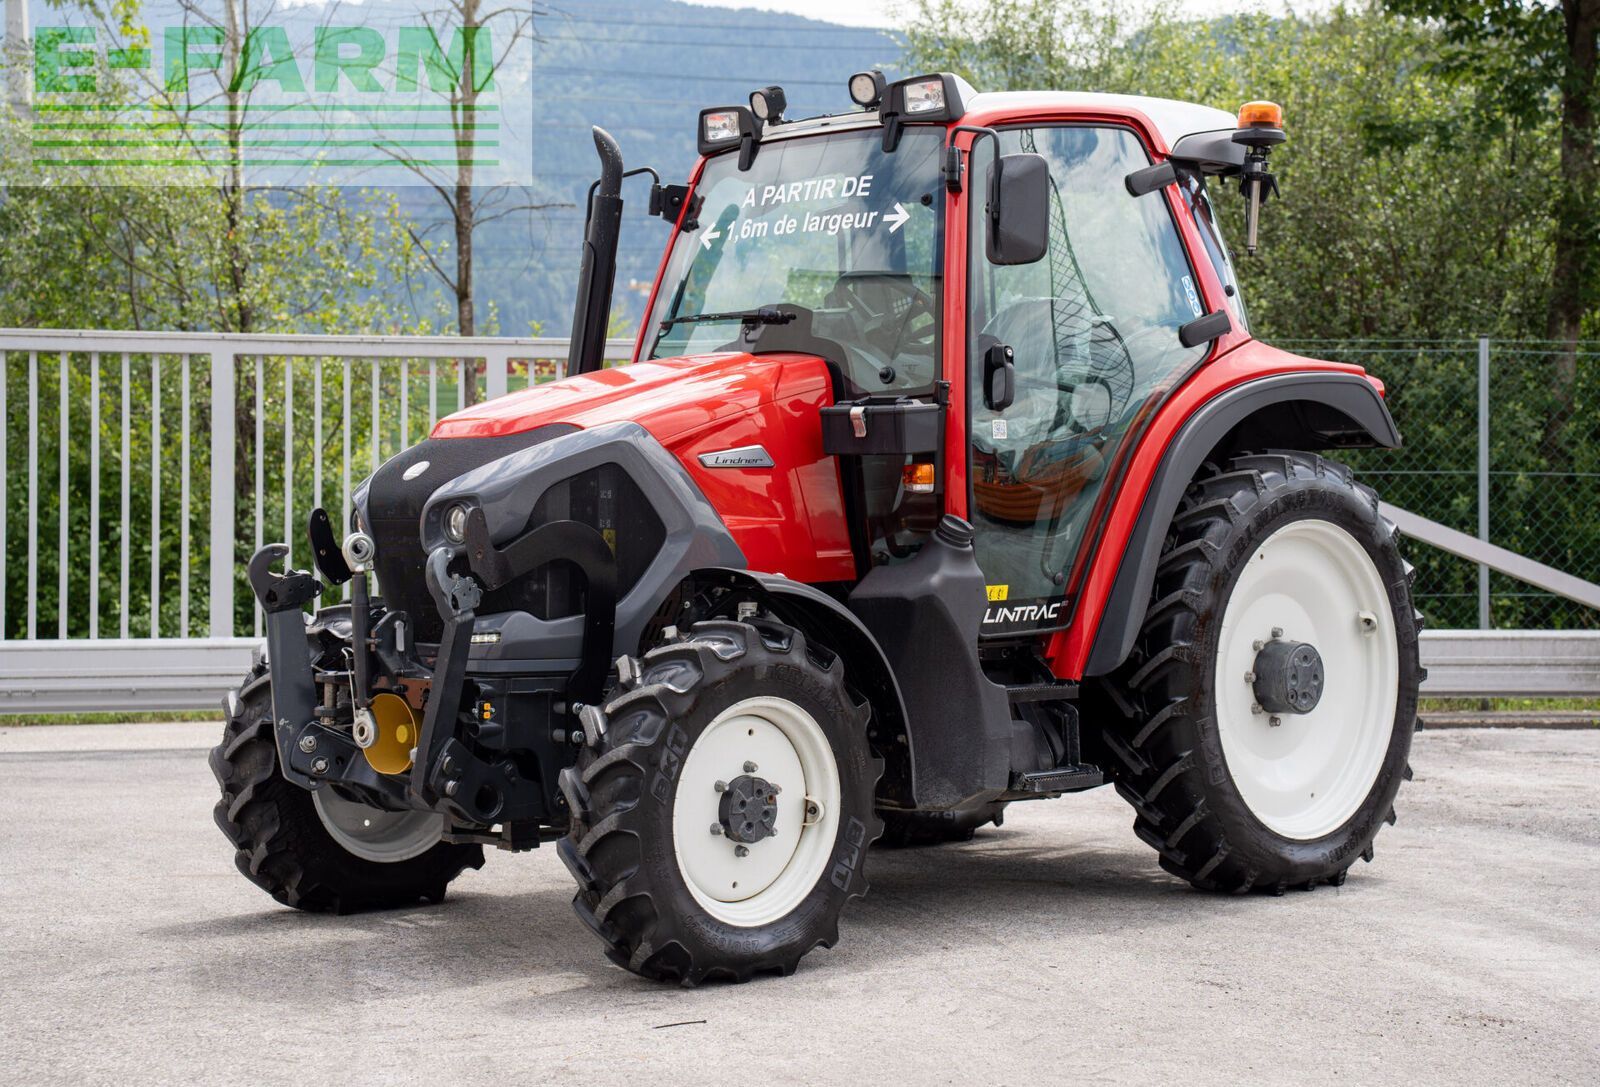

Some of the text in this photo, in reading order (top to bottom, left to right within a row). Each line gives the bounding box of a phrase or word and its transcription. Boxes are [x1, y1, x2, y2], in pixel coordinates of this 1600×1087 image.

[741, 175, 874, 209] A PARTIR DE
[726, 211, 878, 243] 1,6m de largeur
[714, 455, 764, 465] Lindner
[982, 603, 1061, 624] LINTRAC
[650, 722, 688, 806] BKT
[831, 818, 866, 892] BKT
